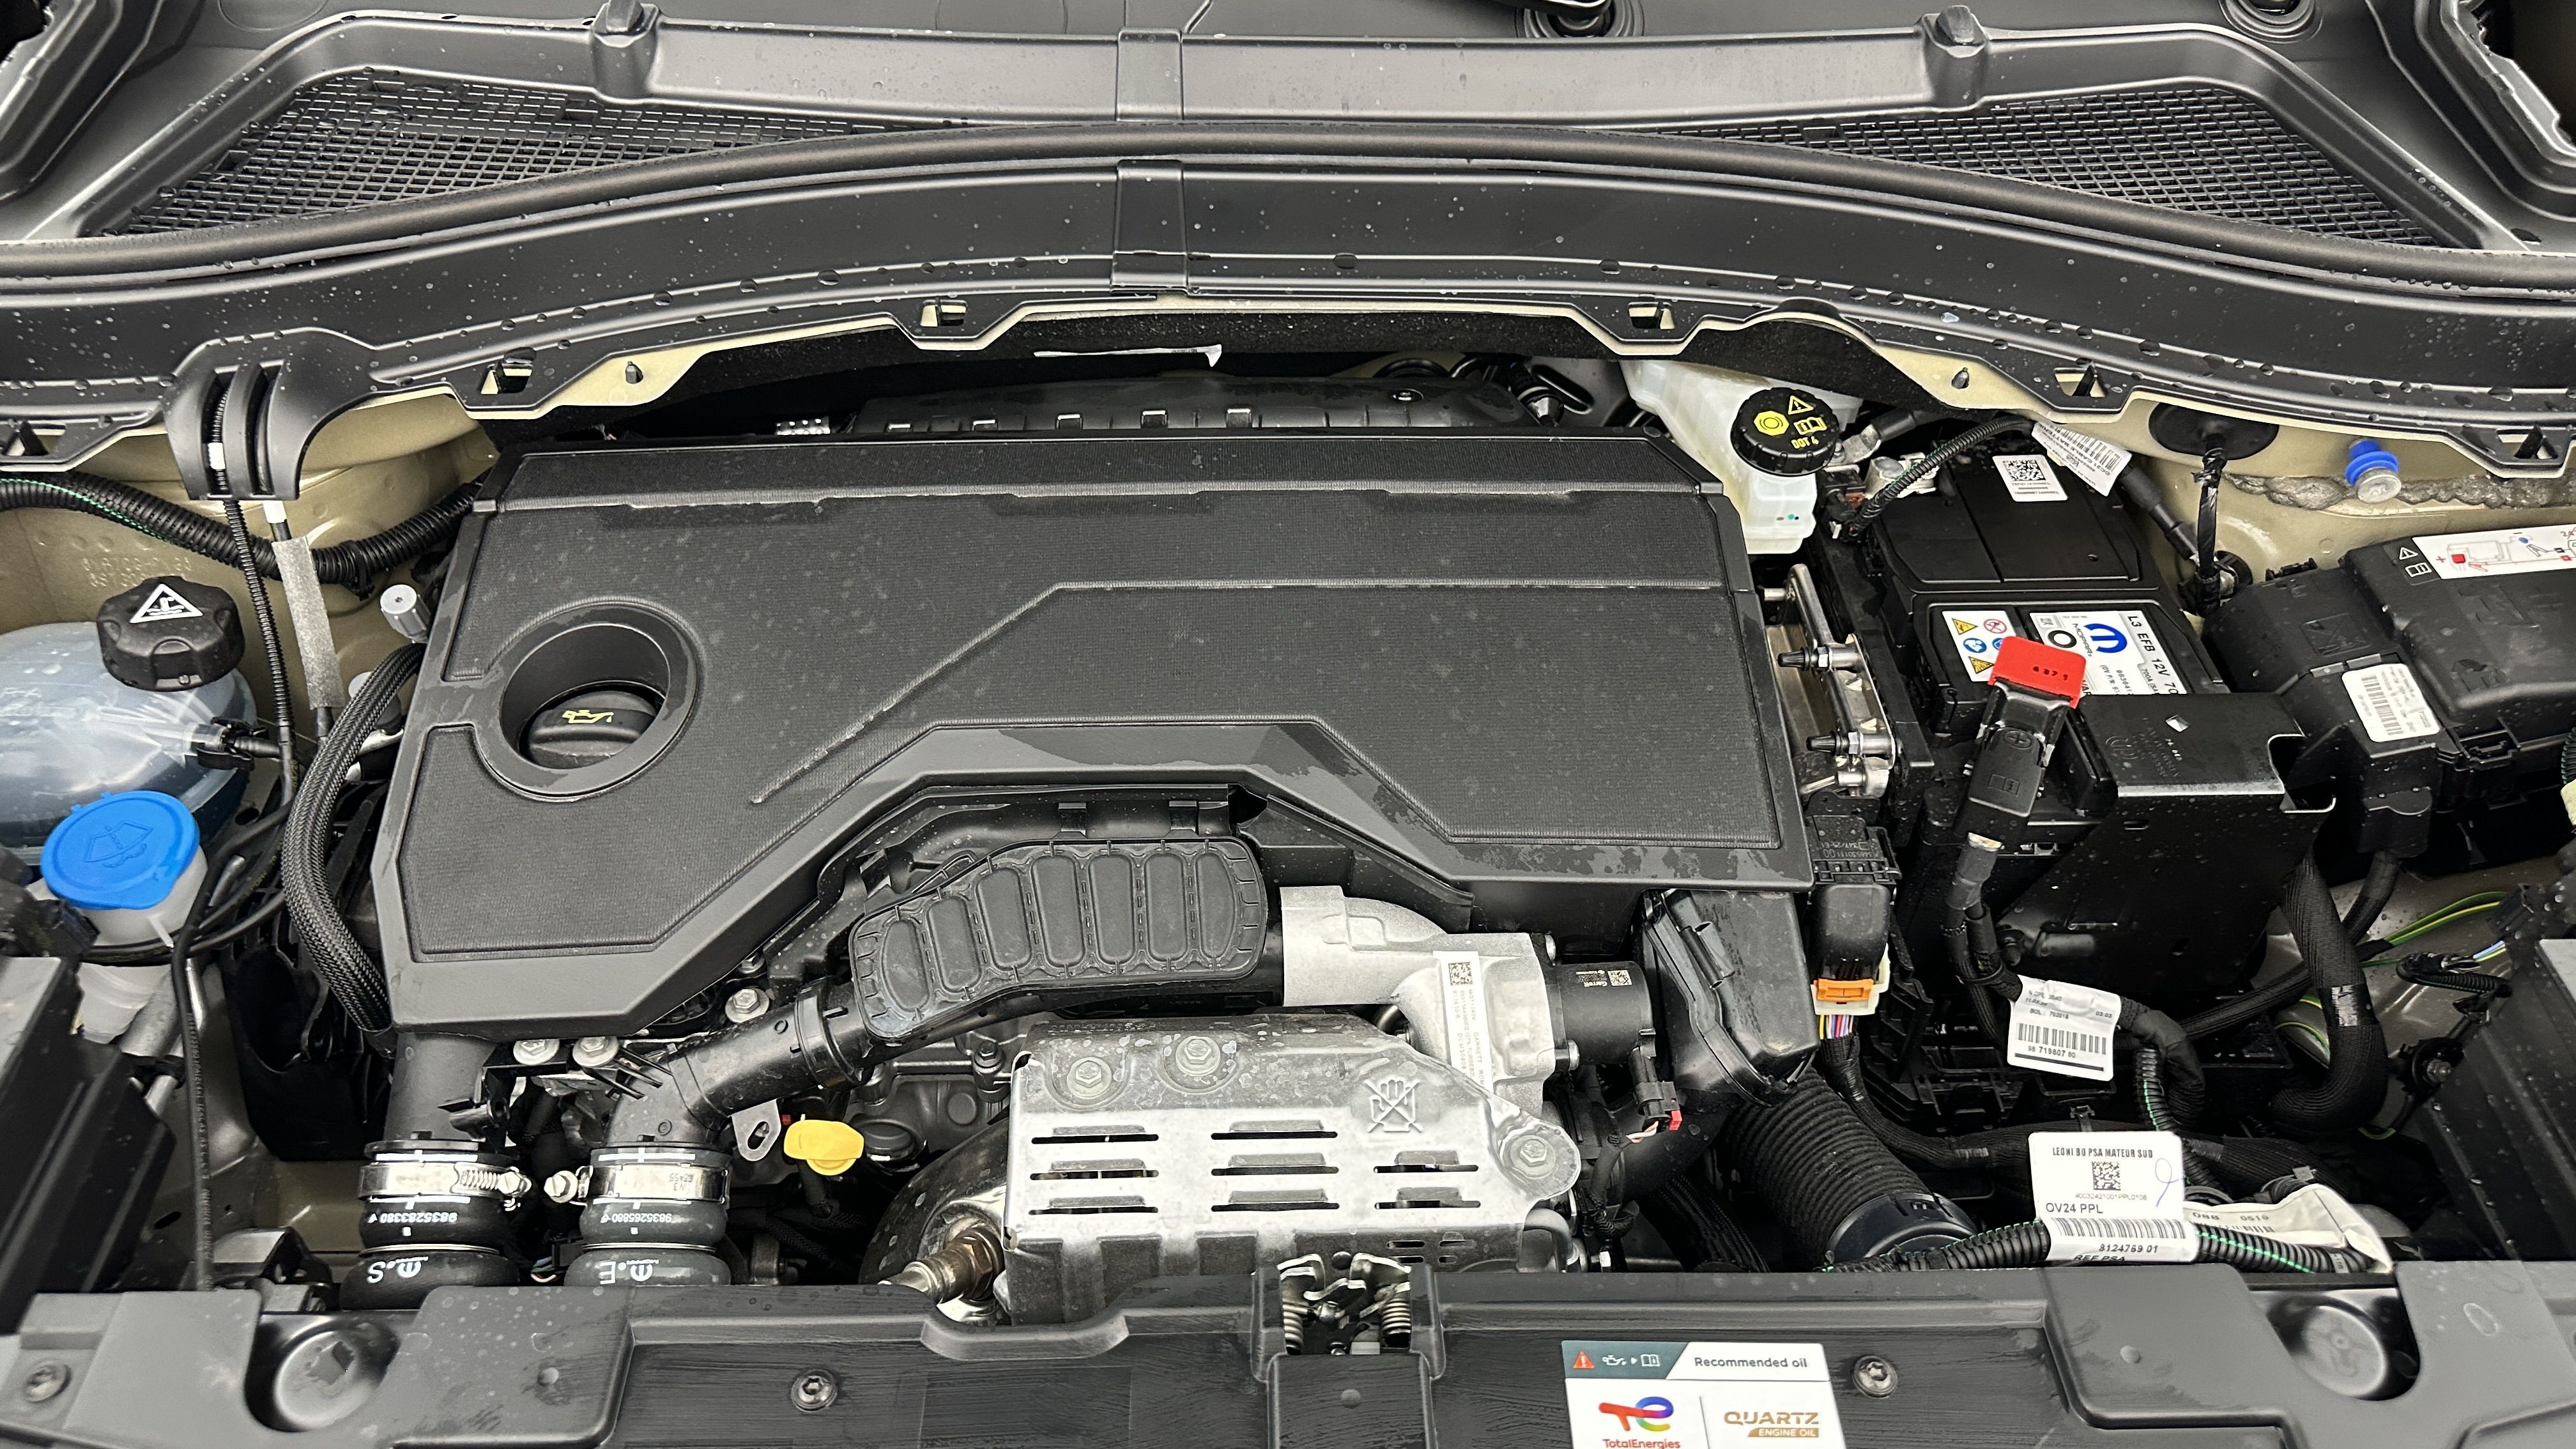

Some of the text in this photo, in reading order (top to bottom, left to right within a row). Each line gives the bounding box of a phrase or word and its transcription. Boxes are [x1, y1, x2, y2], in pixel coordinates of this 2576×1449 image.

[2128, 616, 2142, 627] L3
[2137, 633, 2155, 652] EFB
[2151, 659, 2170, 676] 12V
[2039, 1046, 2066, 1057] 719807
[2052, 1147, 2074, 1156] LEONI
[2076, 1147, 2086, 1156] BU
[2089, 1148, 2103, 1157] PSA
[2105, 1148, 2135, 1158] MATEUR
[2080, 1204, 2103, 1214] PPL
[379, 1212, 458, 1223] 9835283380
[2146, 1245, 2158, 1254] 01
[1694, 1357, 1807, 1367] Recommended oil
[1724, 1411, 1820, 1425] QUARTZ
[1758, 1429, 1816, 1437] ENGINE OIL
[1602, 1439, 1681, 1449] TotalEnergies
